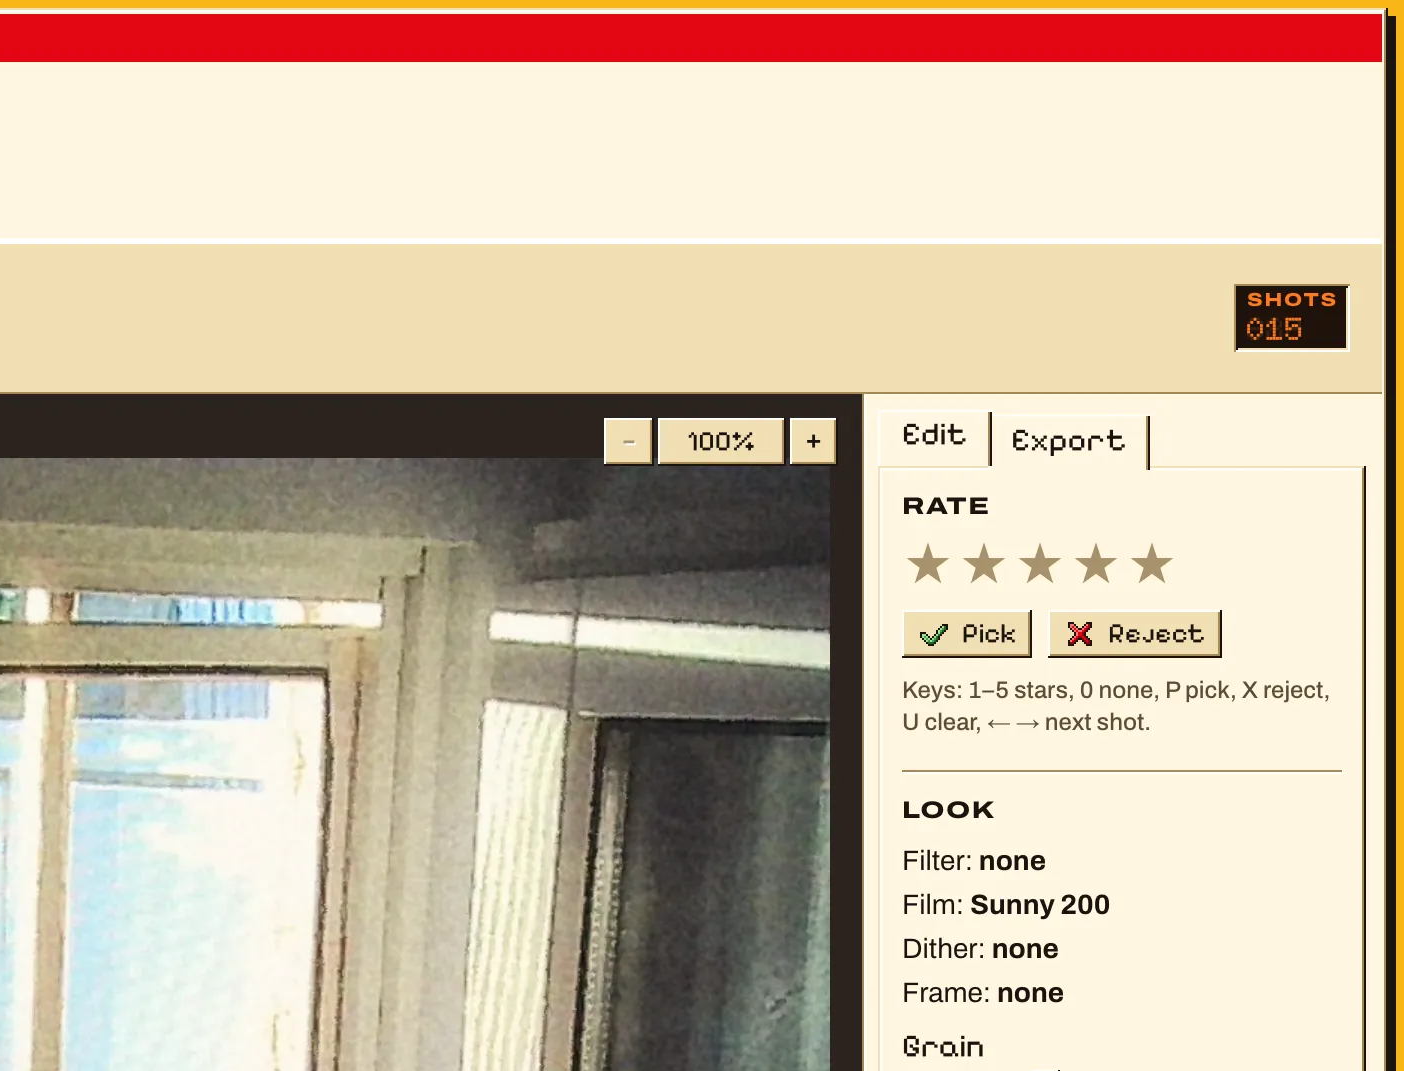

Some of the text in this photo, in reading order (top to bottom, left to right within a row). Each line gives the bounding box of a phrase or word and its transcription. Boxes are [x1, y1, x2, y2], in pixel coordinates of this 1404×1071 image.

[1247, 292, 1336, 307] SHOTS
[1246, 317, 1302, 341] 015
[688, 431, 755, 451] 100%
[903, 423, 967, 446] Edit
[1012, 429, 1126, 457] Export
[903, 496, 989, 515] RATE
[963, 623, 1016, 643] Pick
[1109, 623, 1205, 644] Reject
[903, 680, 1329, 703] Keys: 1–5 stars, 0 none, P pick, X reject,
[903, 712, 981, 735] U clear,
[1045, 712, 1150, 731] next shot.
[903, 800, 995, 819] LOOK
[903, 849, 1046, 871] Filter: none
[903, 893, 1110, 920] Film: Sunny 200
[903, 937, 1059, 959] Dither: none
[903, 982, 1064, 1003] Frame: none
[903, 1035, 984, 1058] Grain
